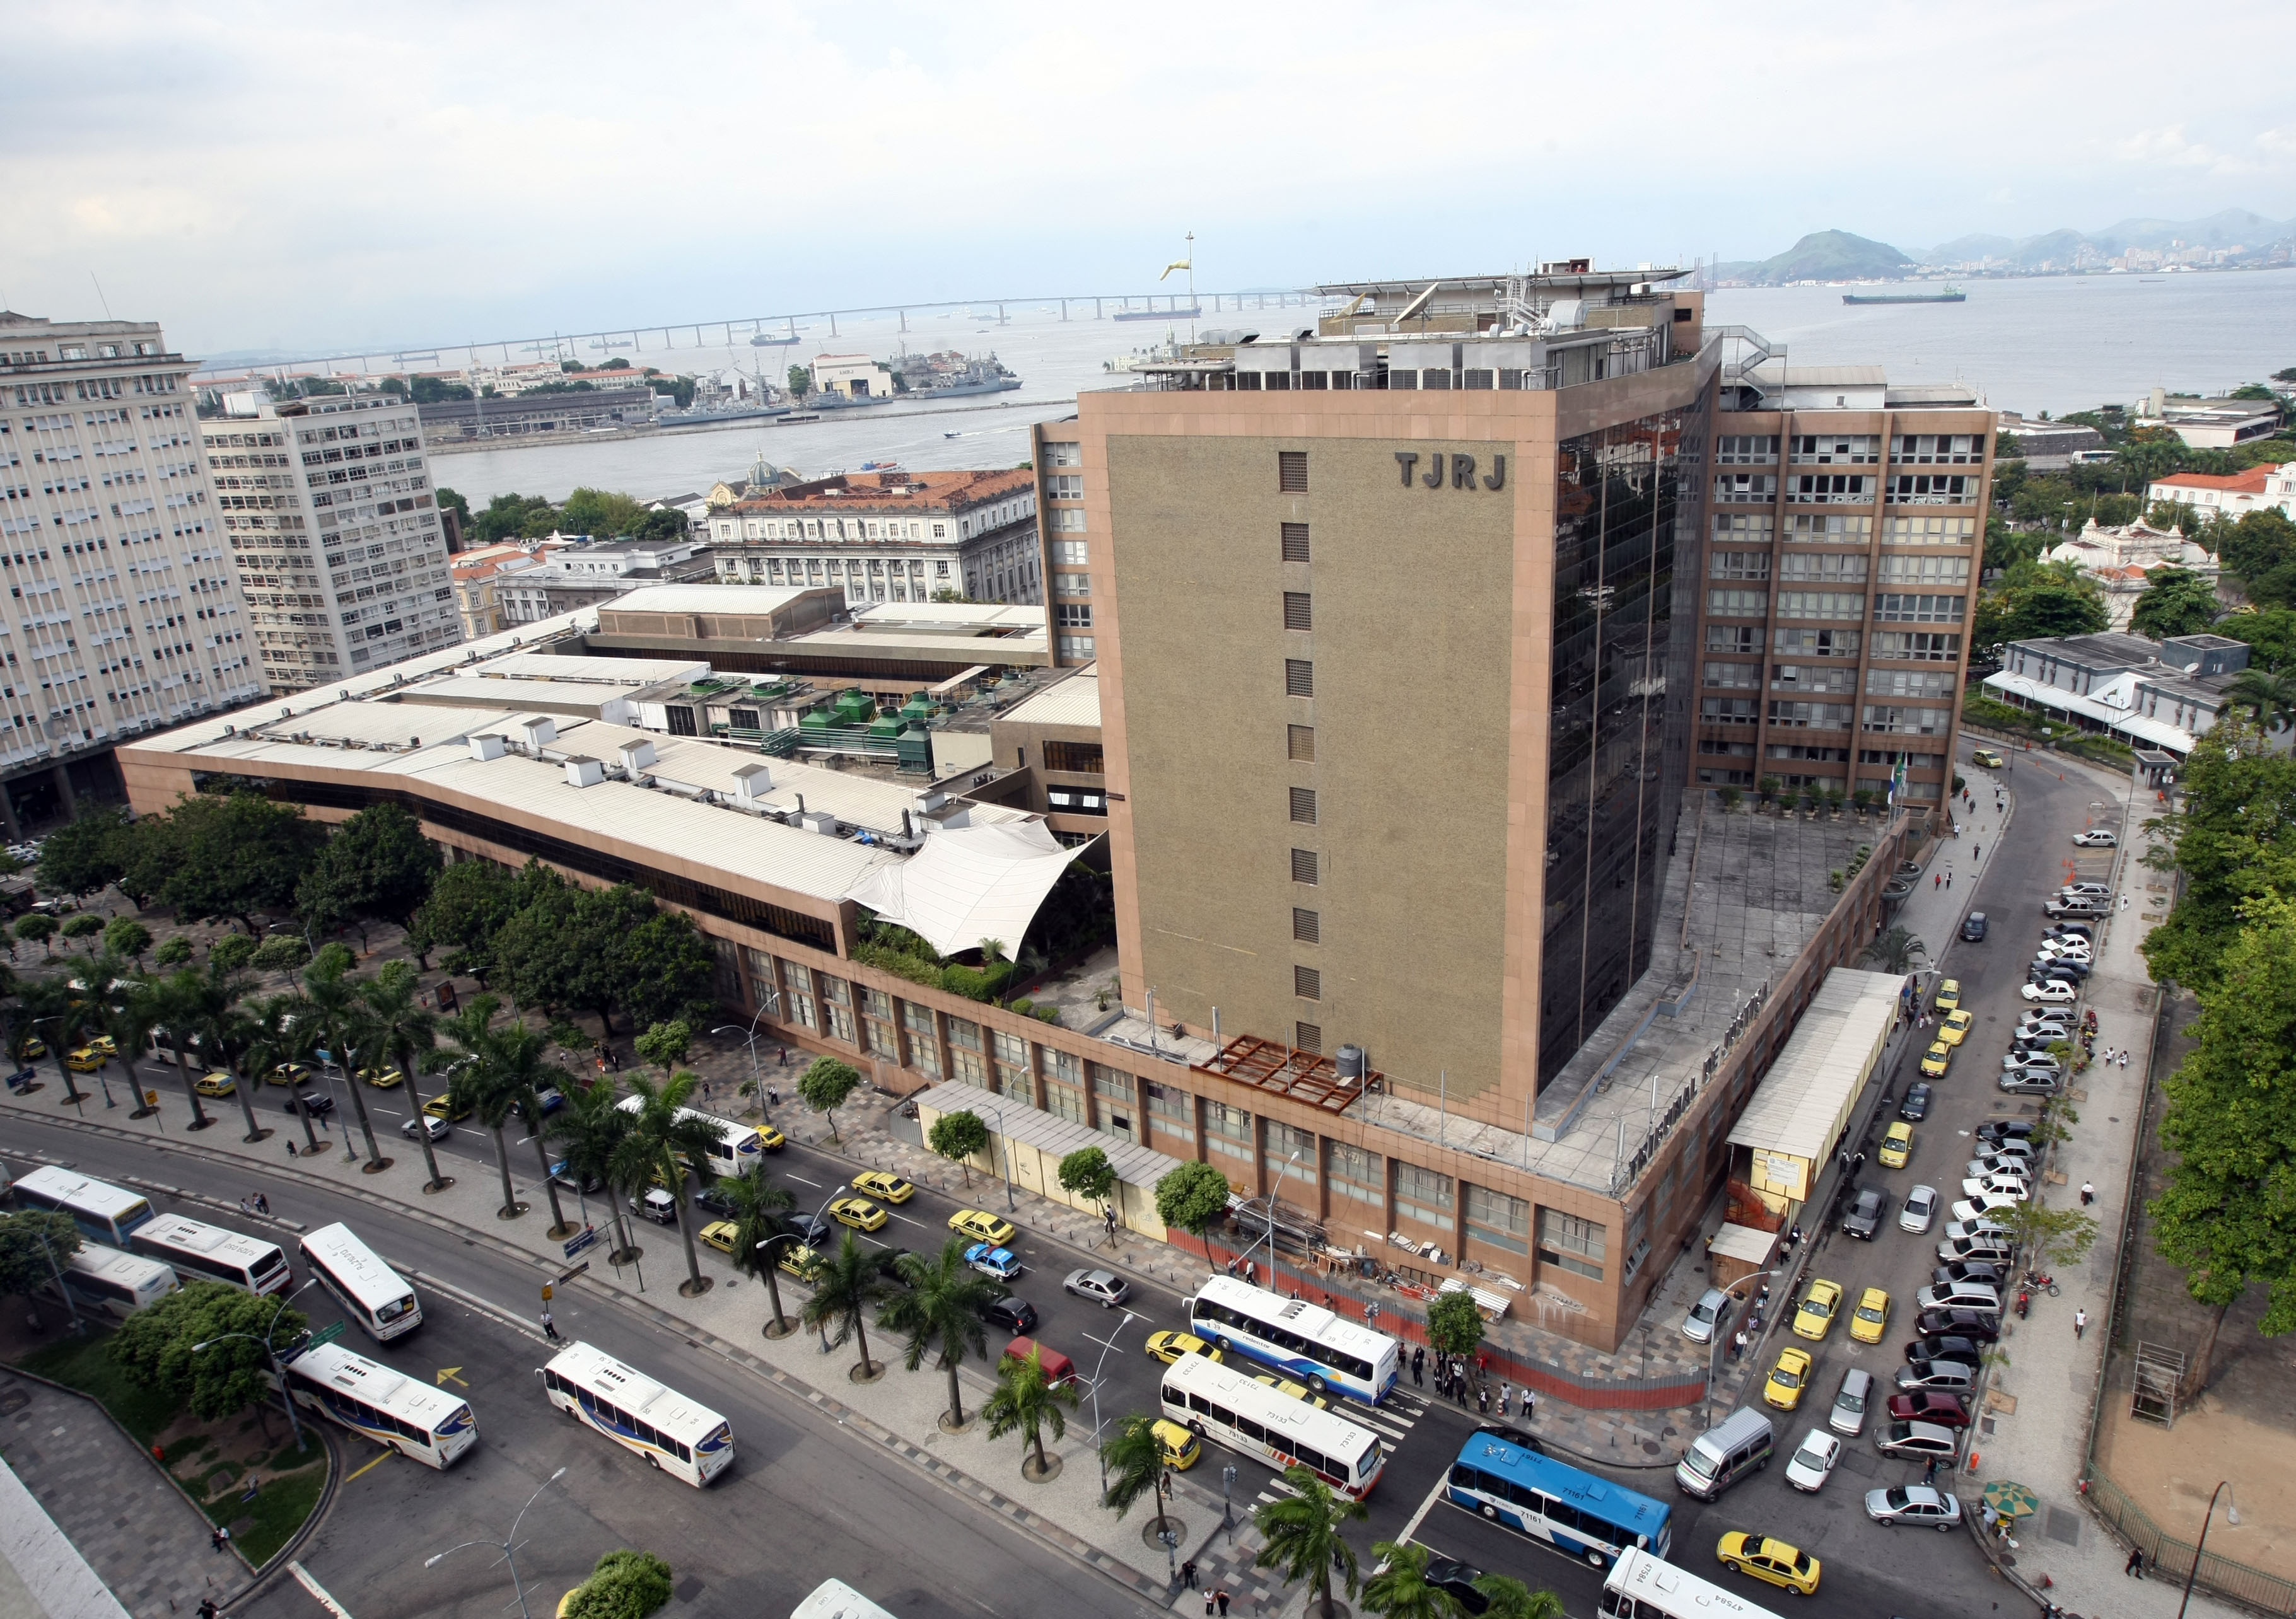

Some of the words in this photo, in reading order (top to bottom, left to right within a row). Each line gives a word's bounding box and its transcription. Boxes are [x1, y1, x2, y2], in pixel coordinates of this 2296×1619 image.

[1394, 451, 1505, 489] TJRJ
[1242, 1335, 1271, 1349] redentor
[1182, 1361, 1199, 1376] 73133
[1238, 1378, 1259, 1391] 73133
[1266, 1411, 1288, 1424] 73133
[1228, 1429, 1248, 1443] 73133
[1339, 1431, 1356, 1449] 73133
[1522, 1453, 1543, 1465] 71161
[1563, 1487, 1585, 1500] 71161
[1520, 1510, 1542, 1524] 71161
[1635, 1503, 1648, 1521] 71161
[1636, 1562, 1653, 1584] 47584
[1715, 1594, 1744, 1611] 47584
